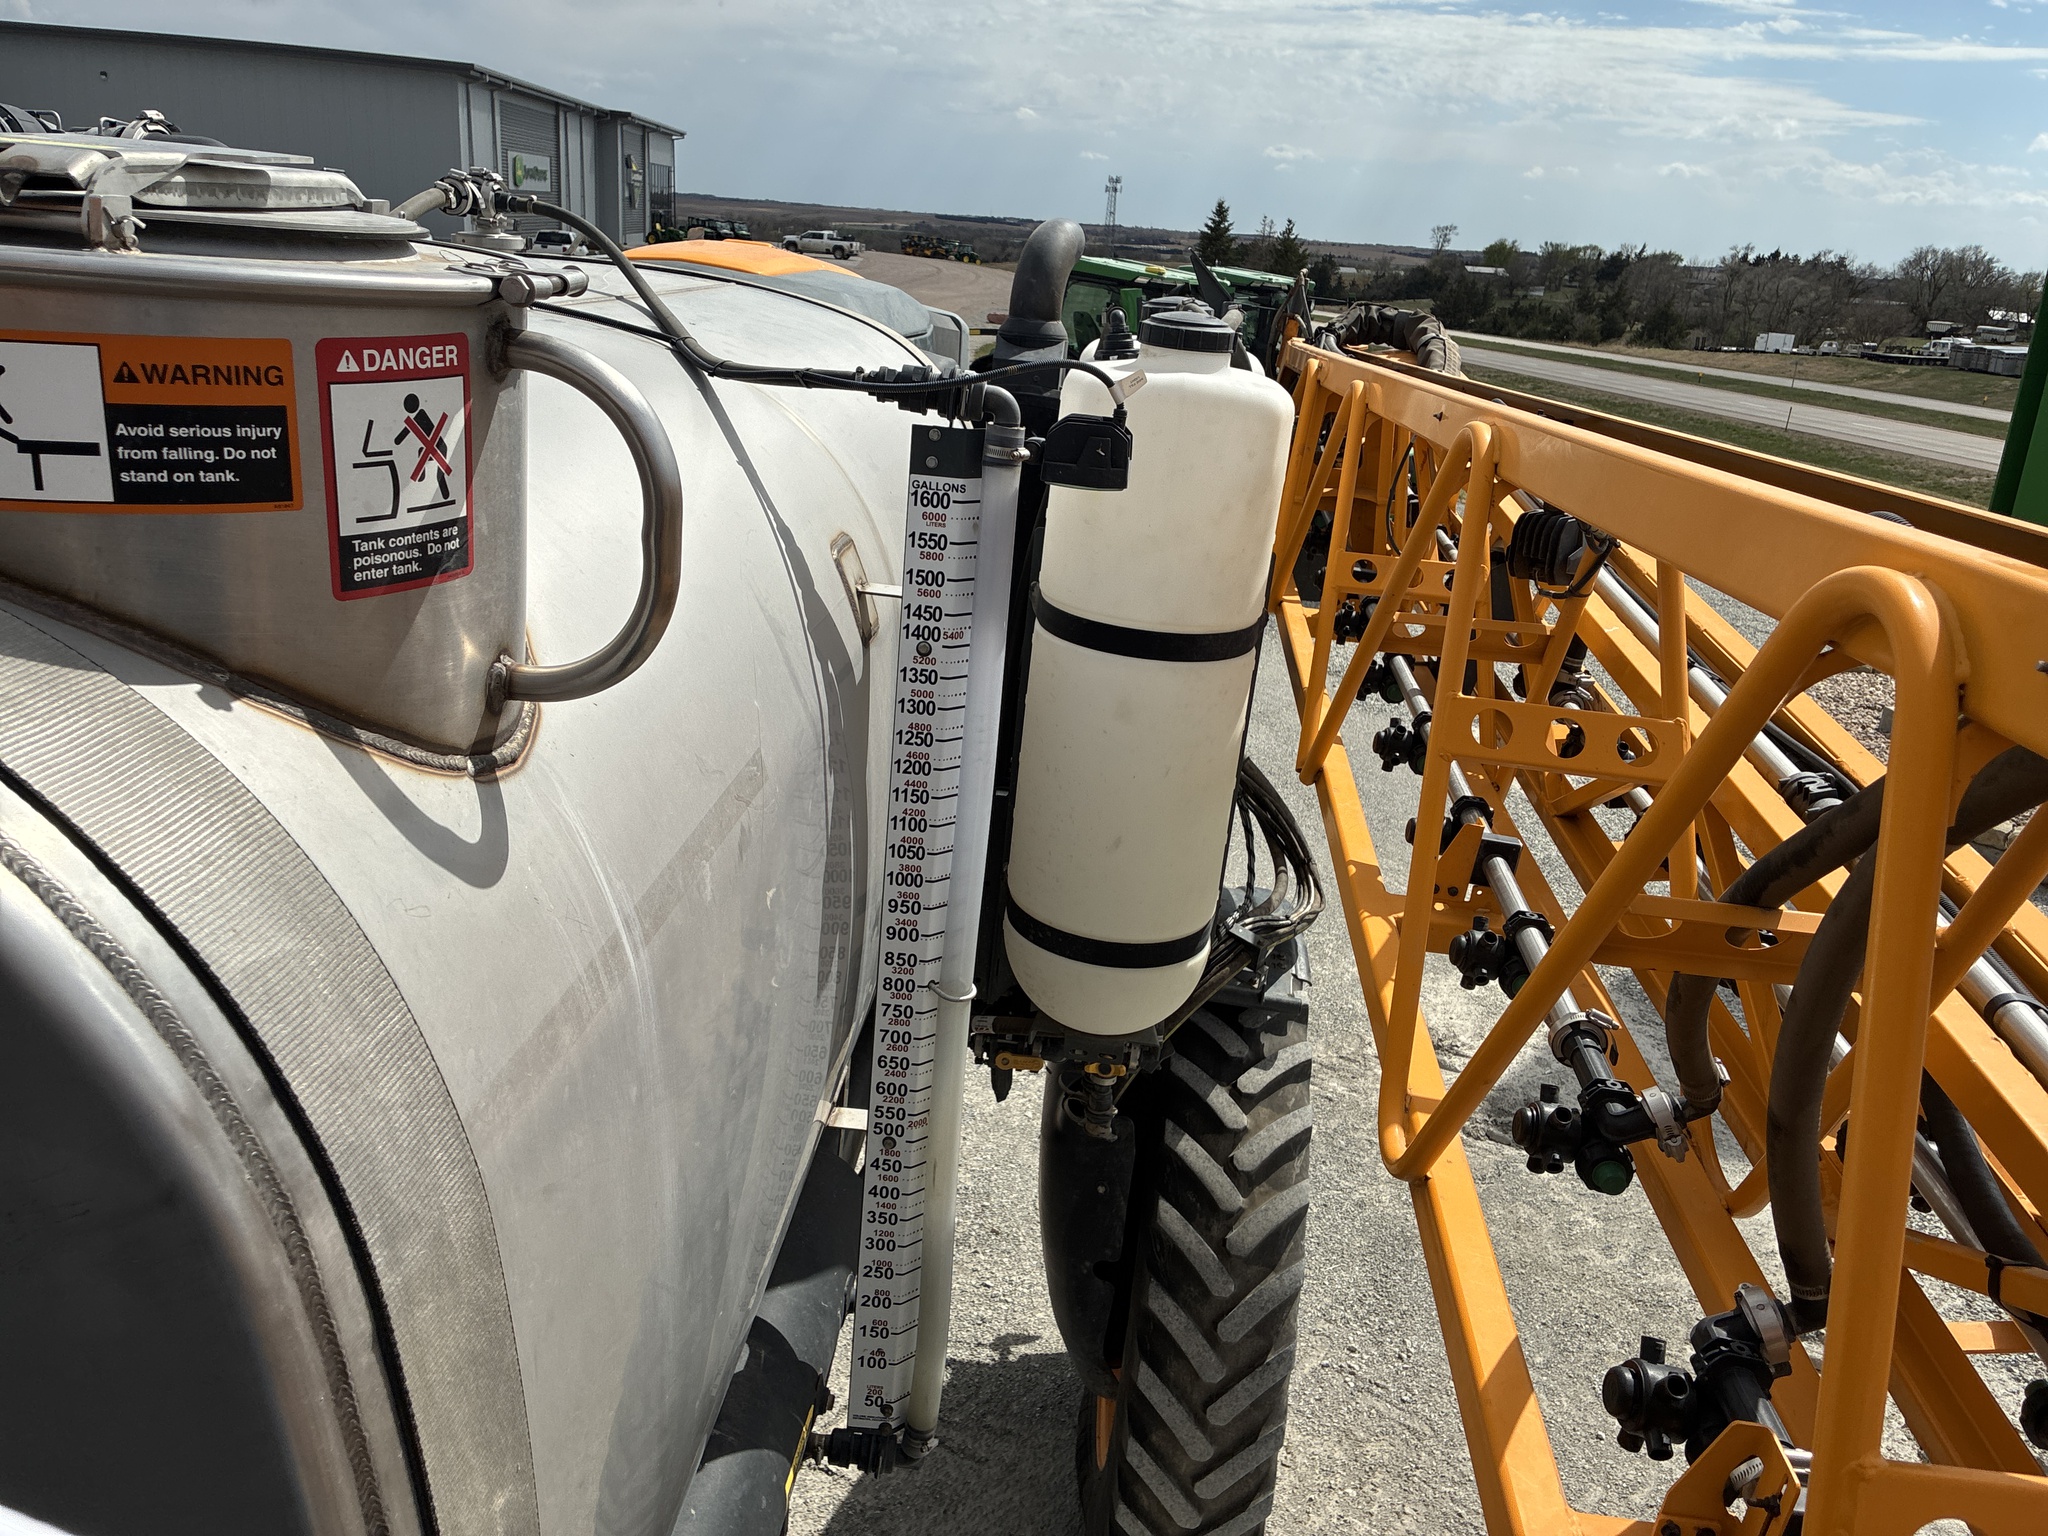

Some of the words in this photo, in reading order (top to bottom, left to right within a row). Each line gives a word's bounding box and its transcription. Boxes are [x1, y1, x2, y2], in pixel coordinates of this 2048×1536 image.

[362, 344, 459, 372] DANGER
[140, 363, 284, 387] WARNING
[115, 423, 165, 437] Avoid
[169, 424, 232, 438] serious
[236, 424, 282, 440] injury
[117, 446, 158, 460] from
[161, 447, 220, 463] falling.
[223, 447, 247, 460] Do
[251, 447, 278, 459] not
[120, 469, 169, 483] stand
[173, 472, 195, 483] on
[199, 469, 240, 483] tank.
[911, 479, 967, 494] GALLONS
[910, 489, 951, 510] 1600
[921, 511, 947, 523] 6000
[925, 521, 947, 529] LITERS
[351, 537, 386, 553] Tank
[388, 529, 440, 547] contents
[442, 525, 459, 538] are
[908, 530, 948, 551] 1550
[353, 548, 423, 571] poisonous.
[427, 542, 442, 555] Do
[444, 537, 460, 552] not
[919, 550, 945, 562] 5800
[353, 566, 390, 582] enter
[391, 560, 423, 576] tank.
[905, 567, 946, 588] 1500
[916, 588, 942, 599] 5600
[903, 602, 943, 623] 1450
[902, 622, 941, 643] 1400
[942, 630, 964, 640] 5400
[912, 655, 937, 666] 5200
[899, 666, 939, 686] 1350
[910, 688, 935, 700] 5000
[897, 697, 936, 717] 1300
[907, 721, 932, 732] 4800
[895, 729, 934, 748] 1250
[905, 750, 930, 761] 4600
[893, 758, 932, 777] 1200
[903, 779, 928, 789] 4400
[892, 786, 930, 805] 1150
[901, 807, 926, 818] 4200
[890, 815, 928, 833] 1100
[900, 835, 924, 846] 4000
[888, 843, 926, 861] 1050
[898, 863, 922, 873] 3800
[886, 870, 924, 888] 1000
[896, 890, 920, 900] 3600
[887, 898, 922, 916] 950
[894, 917, 918, 928] 3400
[885, 925, 920, 943] 900
[884, 951, 918, 968] 850
[891, 966, 915, 976] 3200
[882, 976, 916, 993] 800
[889, 991, 913, 1001] 3000
[881, 1002, 914, 1019] 750
[887, 1017, 911, 1027] 2800
[879, 1028, 912, 1045] 700
[885, 1043, 909, 1053] 2600
[877, 1054, 910, 1071] 650
[884, 1069, 907, 1079] 2400
[875, 1081, 908, 1097] 600
[882, 1095, 905, 1105] 2200
[874, 1105, 907, 1121] 550
[873, 1122, 905, 1138] 500
[907, 1117, 928, 1128] 2000
[879, 1148, 901, 1158] 1800
[870, 1157, 902, 1173] 450
[877, 1173, 899, 1183] 1600
[868, 1184, 900, 1200] 400
[875, 1201, 897, 1211] 1400
[866, 1210, 898, 1226] 350
[873, 1229, 895, 1238] 1200
[864, 1236, 896, 1252] 300
[871, 1259, 893, 1268] 1000
[862, 1265, 895, 1280] 250
[874, 1289, 891, 1297] 800
[860, 1294, 892, 1309] 200
[871, 1319, 888, 1327] 600
[859, 1325, 890, 1340] 150
[869, 1349, 886, 1358] 400
[857, 1355, 887, 1370] 100
[866, 1388, 883, 1396] 200
[864, 1395, 885, 1408] 50
